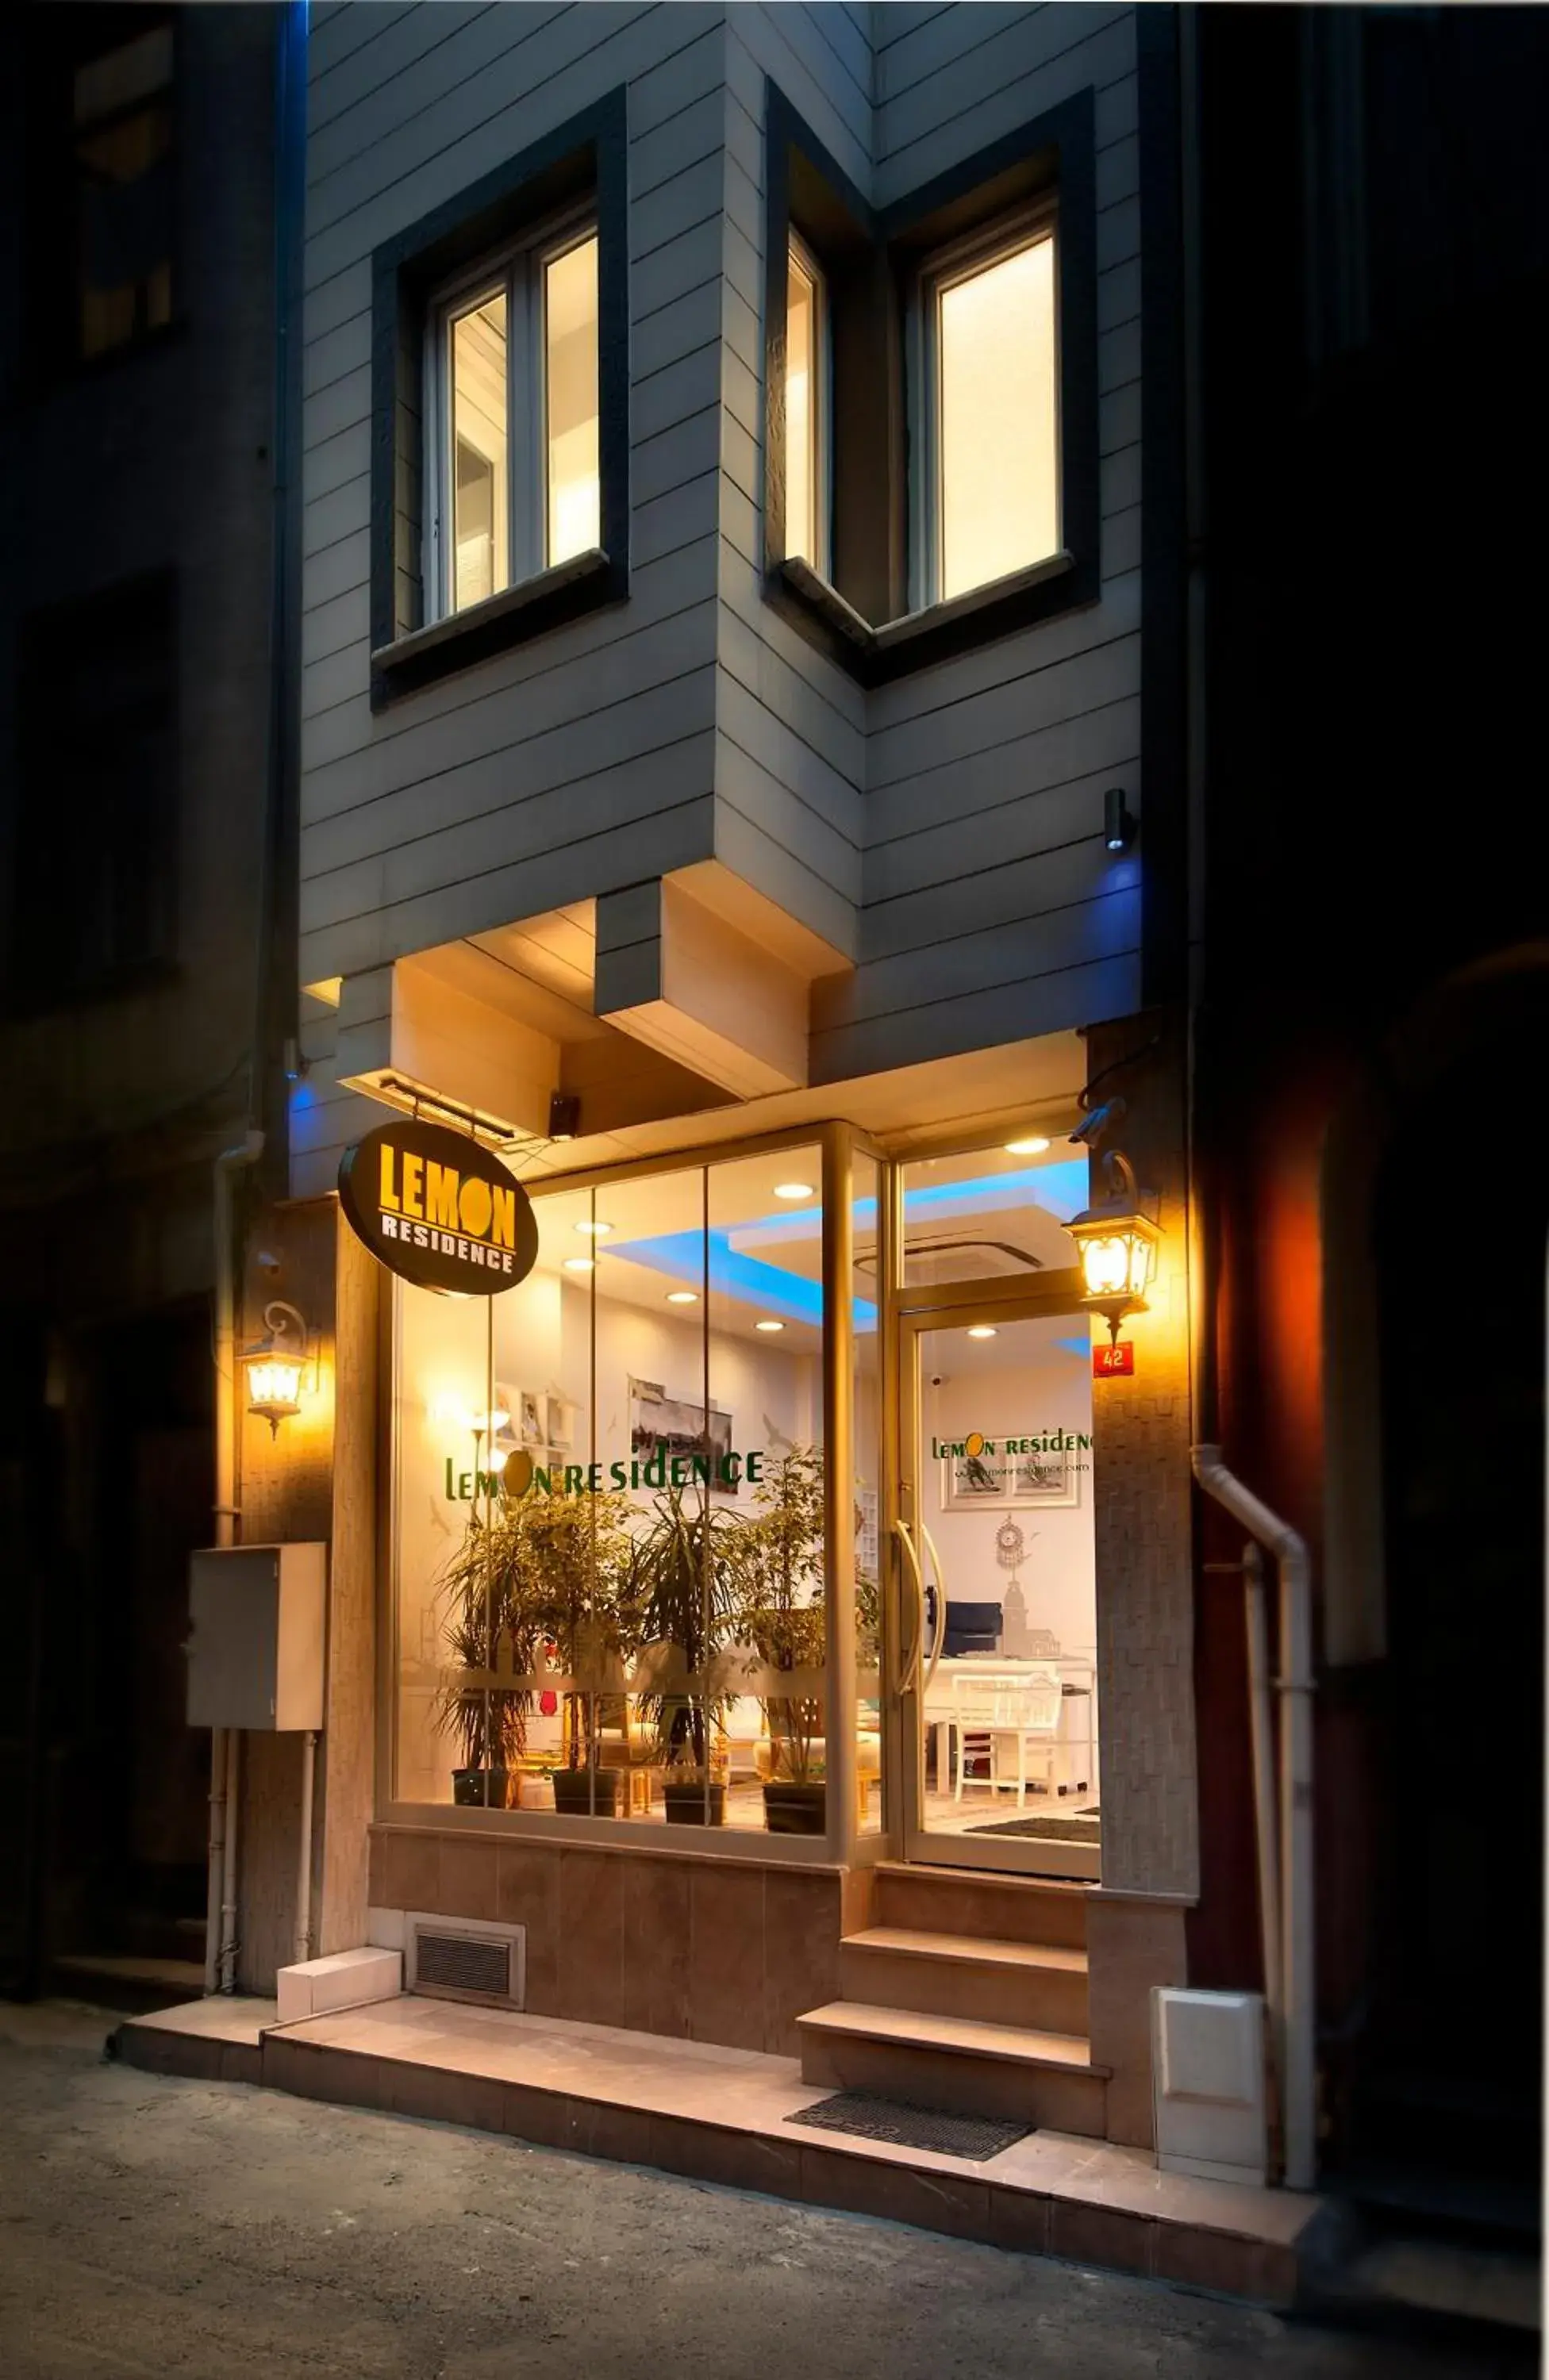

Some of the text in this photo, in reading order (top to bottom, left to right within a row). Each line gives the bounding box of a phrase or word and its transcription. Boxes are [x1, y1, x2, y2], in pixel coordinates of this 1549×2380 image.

[380, 1143, 515, 1250] LEMON
[382, 1214, 513, 1274] RESIDENCE
[1104, 1349, 1124, 1367] 42
